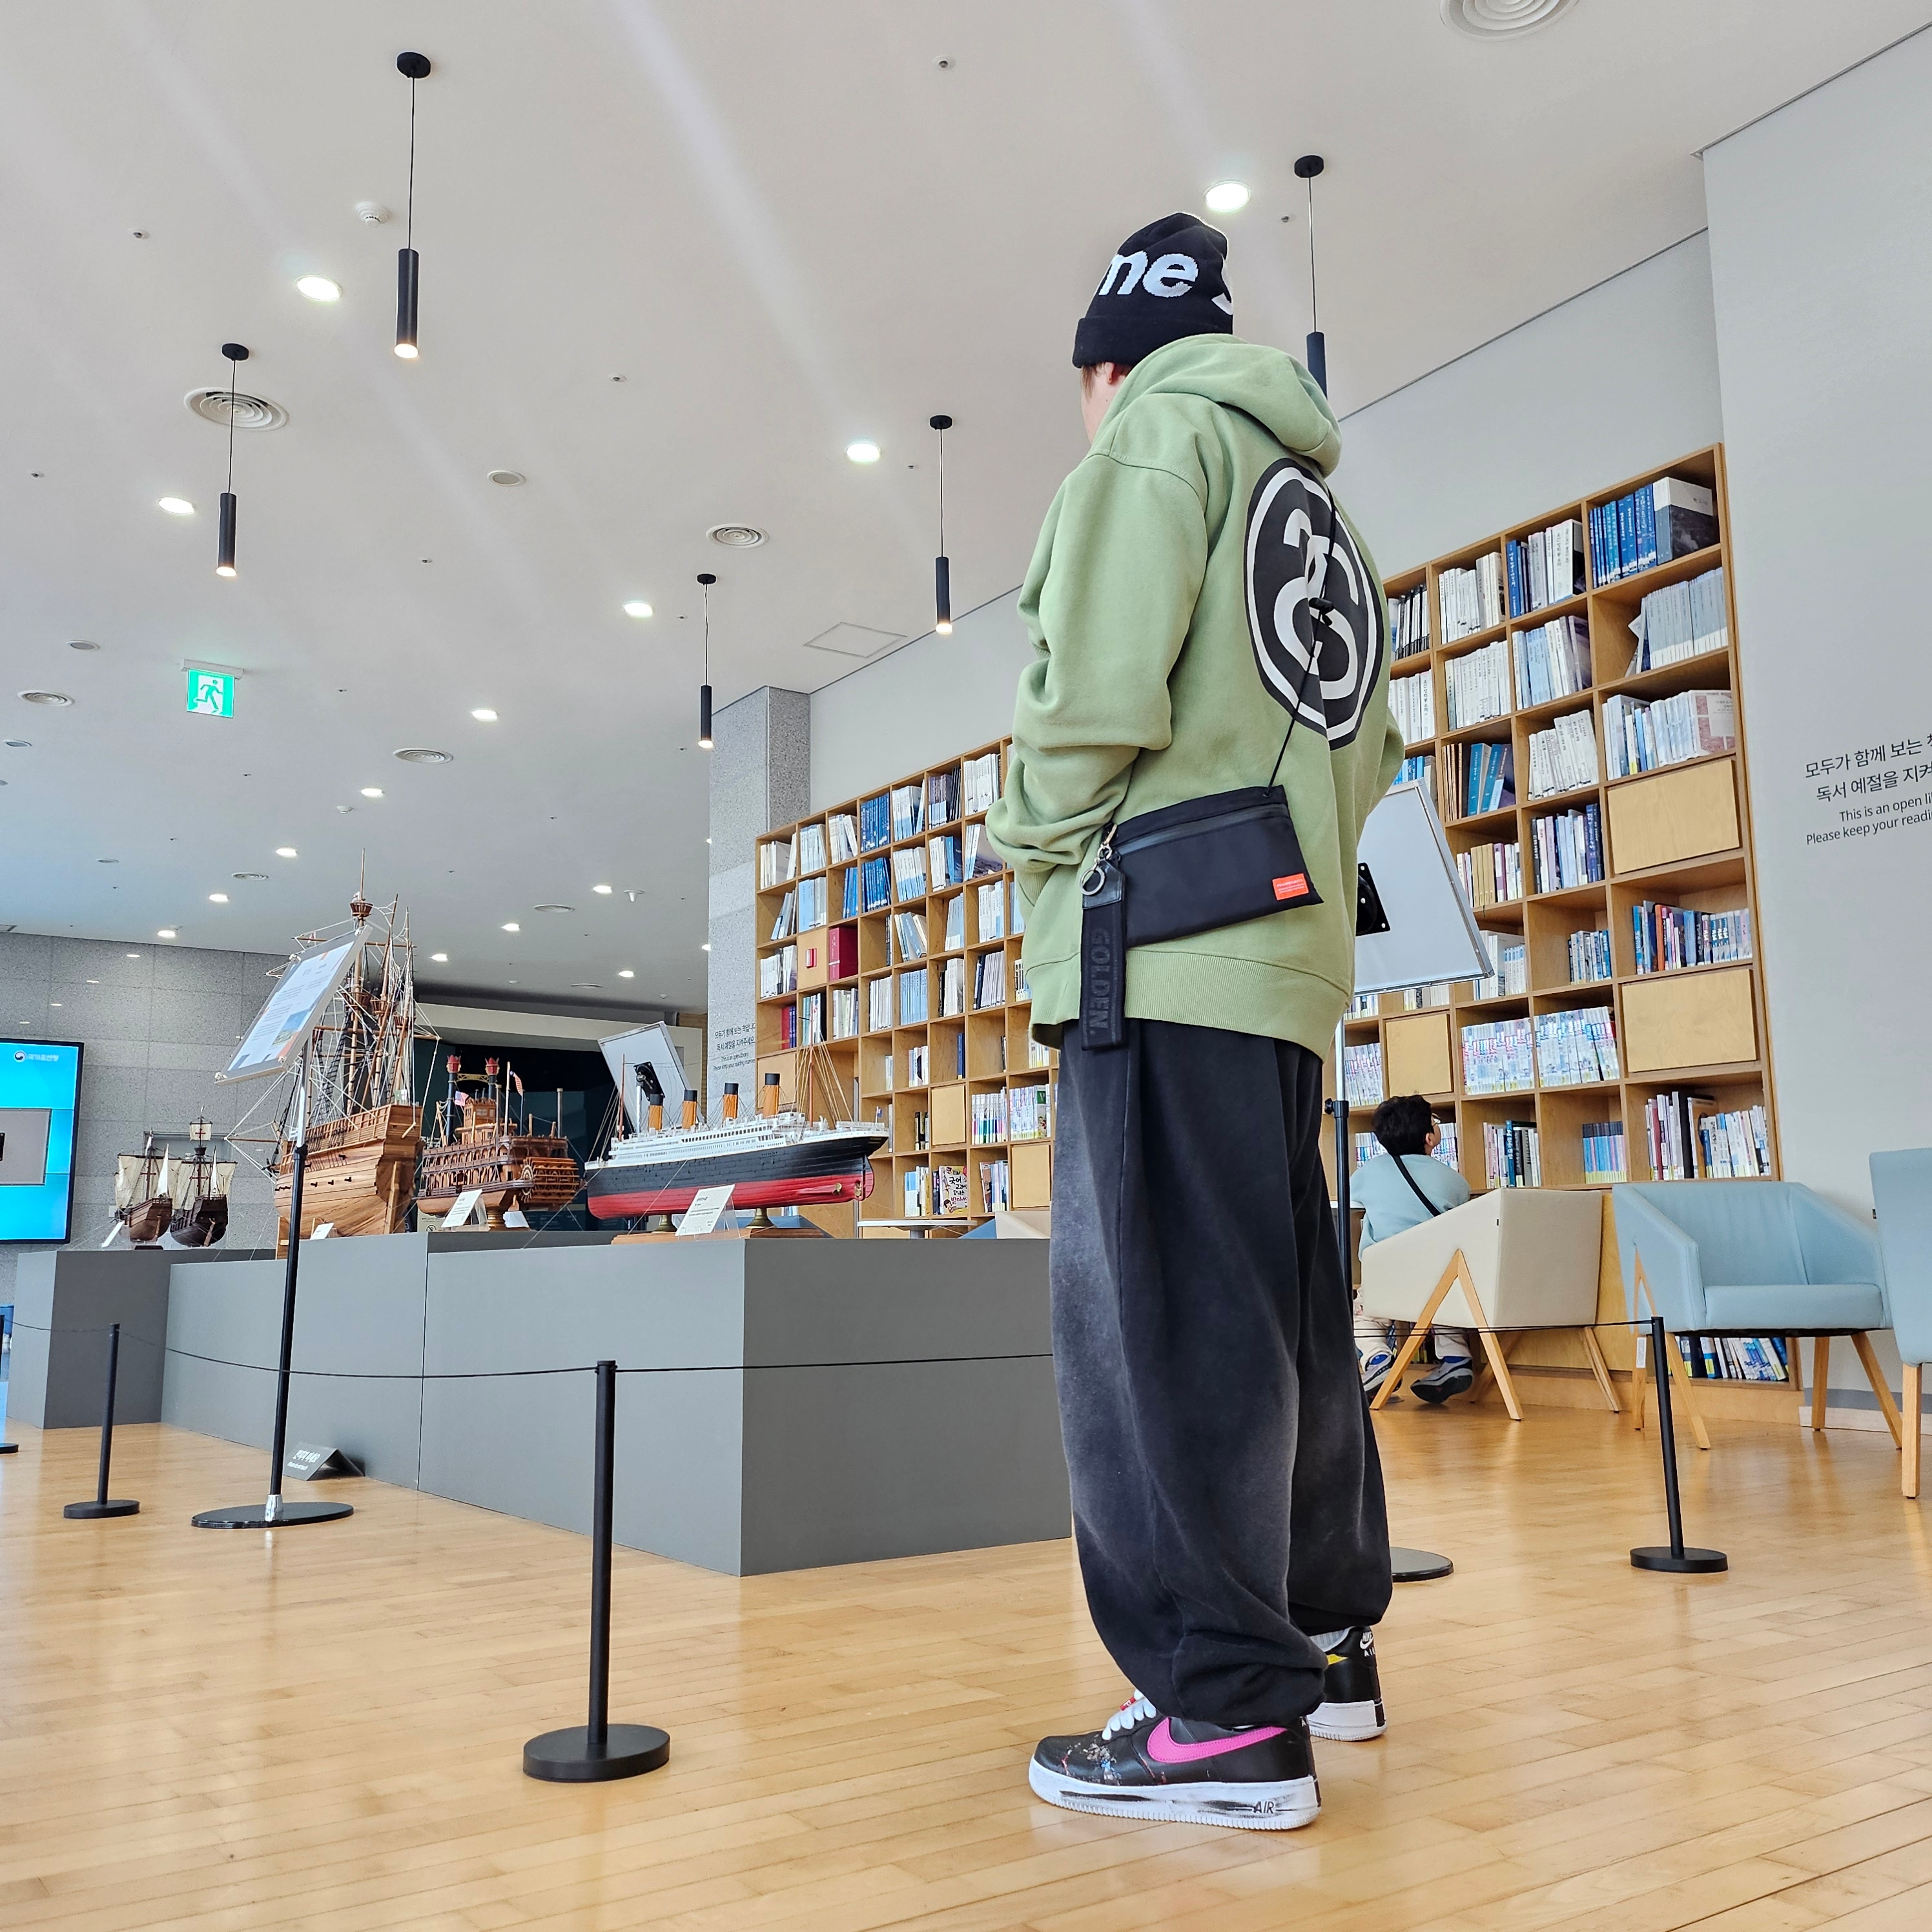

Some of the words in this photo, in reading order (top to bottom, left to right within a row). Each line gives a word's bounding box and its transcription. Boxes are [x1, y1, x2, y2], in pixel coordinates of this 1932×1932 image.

[1805, 754, 1851, 778] 모두가
[1854, 745, 1886, 767] 함께
[1890, 739, 1923, 758] 보는
[1816, 781, 1847, 801] 독서
[1851, 770, 1898, 794] 예절을
[1839, 808, 1862, 822] This
[1864, 806, 1873, 817] is
[1876, 804, 1890, 815] an
[1893, 797, 1922, 813] open
[1806, 830, 1840, 845] Please
[1843, 824, 1870, 837] keep
[1872, 818, 1899, 835] your
[1902, 809, 1932, 826] readi
[949, 1176, 962, 1185] 국어
[1253, 1800, 1275, 1814] AIR
